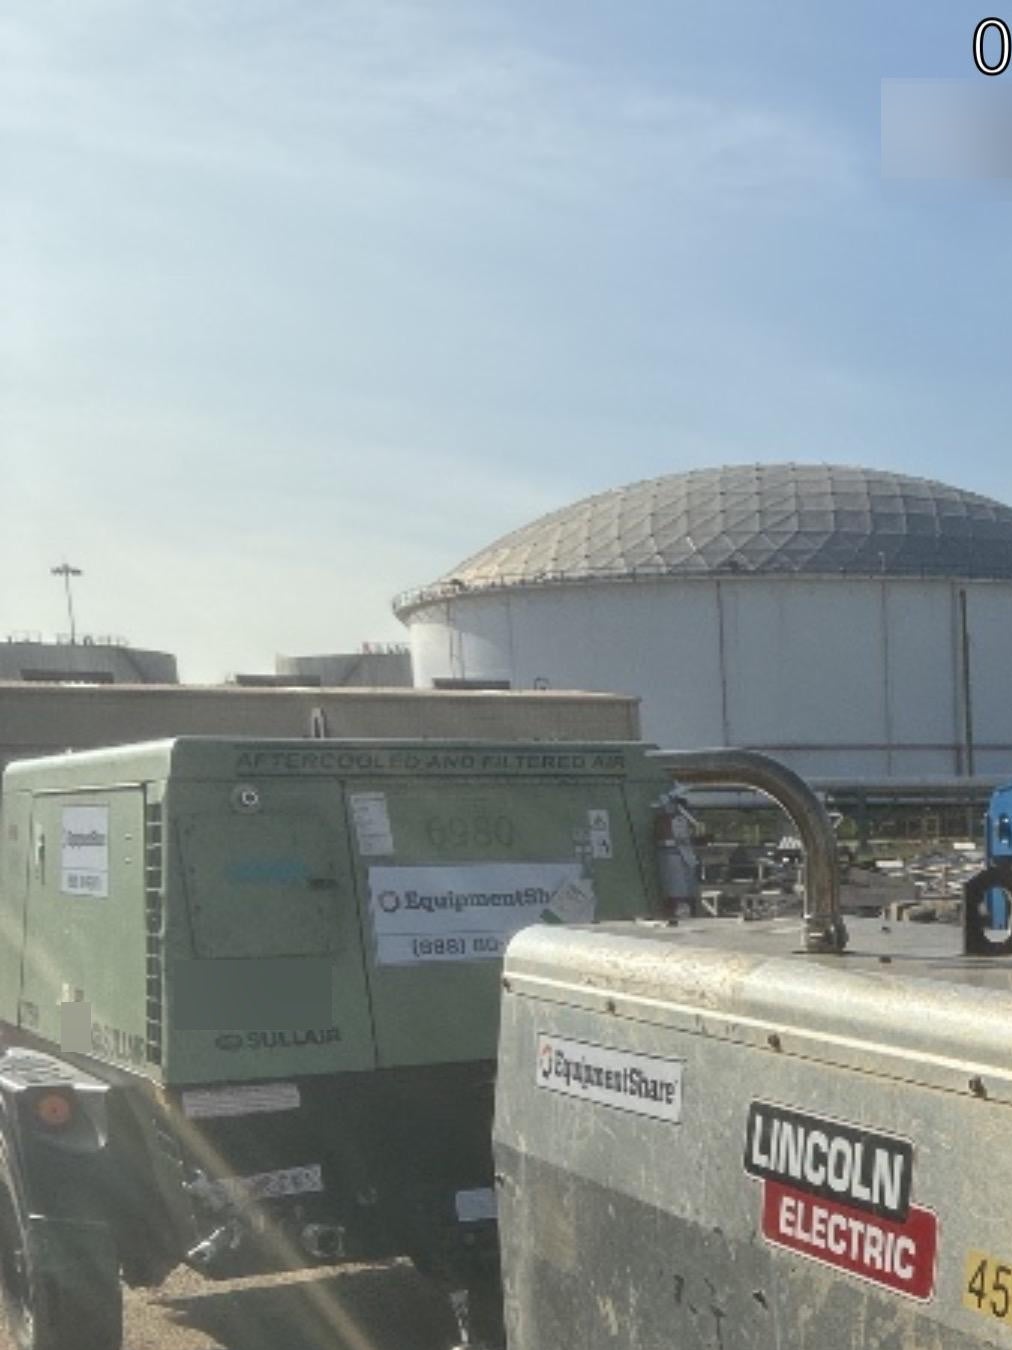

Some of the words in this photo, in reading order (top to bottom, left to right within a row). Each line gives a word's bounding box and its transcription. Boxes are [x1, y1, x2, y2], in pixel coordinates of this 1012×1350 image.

[236, 752, 425, 771] AFTERCOOLED
[427, 754, 476, 770] AND
[482, 755, 586, 770] FILTERED
[590, 755, 625, 770] AIR
[403, 886, 556, 913] EquipmentSh
[246, 1026, 343, 1051] SULLAIR
[553, 1049, 676, 1104] EquipmentShare
[751, 1113, 904, 1210] LINCOLN
[778, 1196, 916, 1281] ELECTRIC
